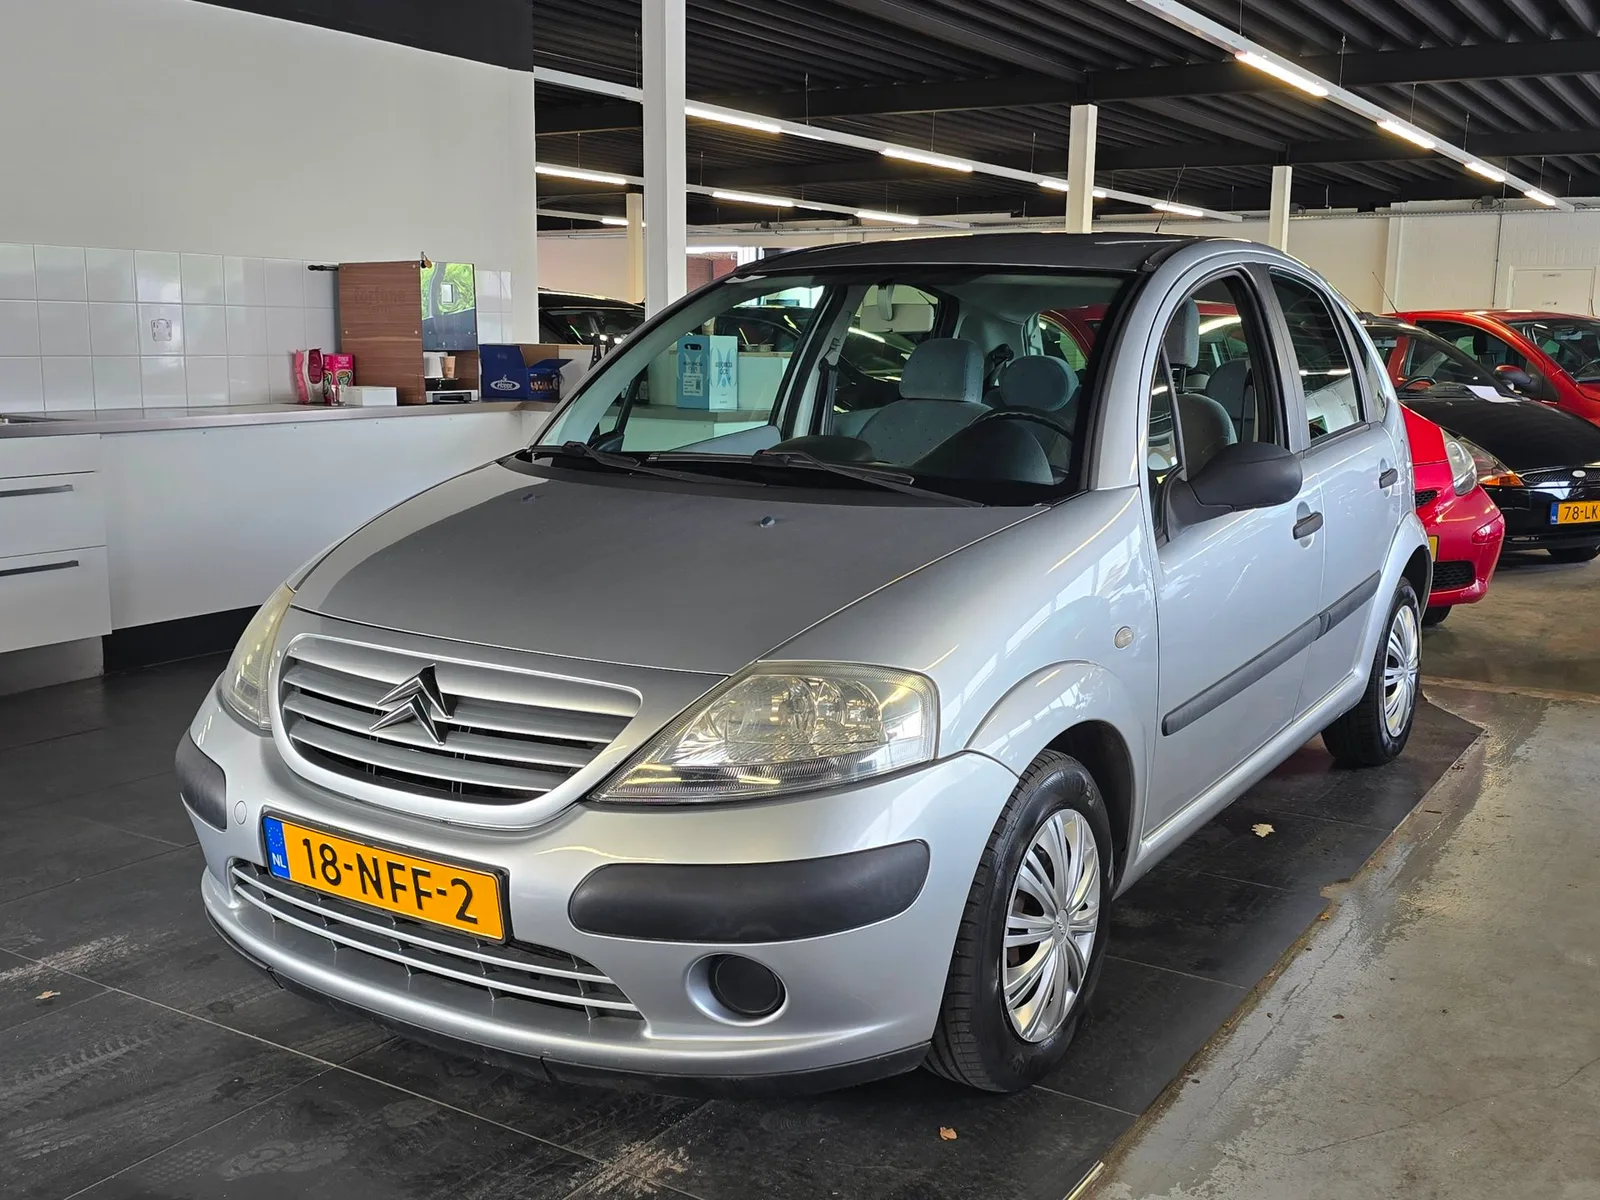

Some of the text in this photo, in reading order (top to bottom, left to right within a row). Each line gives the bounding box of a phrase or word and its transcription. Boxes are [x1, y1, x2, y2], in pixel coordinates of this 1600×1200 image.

[1564, 504, 1600, 521] 78-LK
[271, 852, 287, 870] NL
[302, 837, 479, 925] 18-NFF-2
